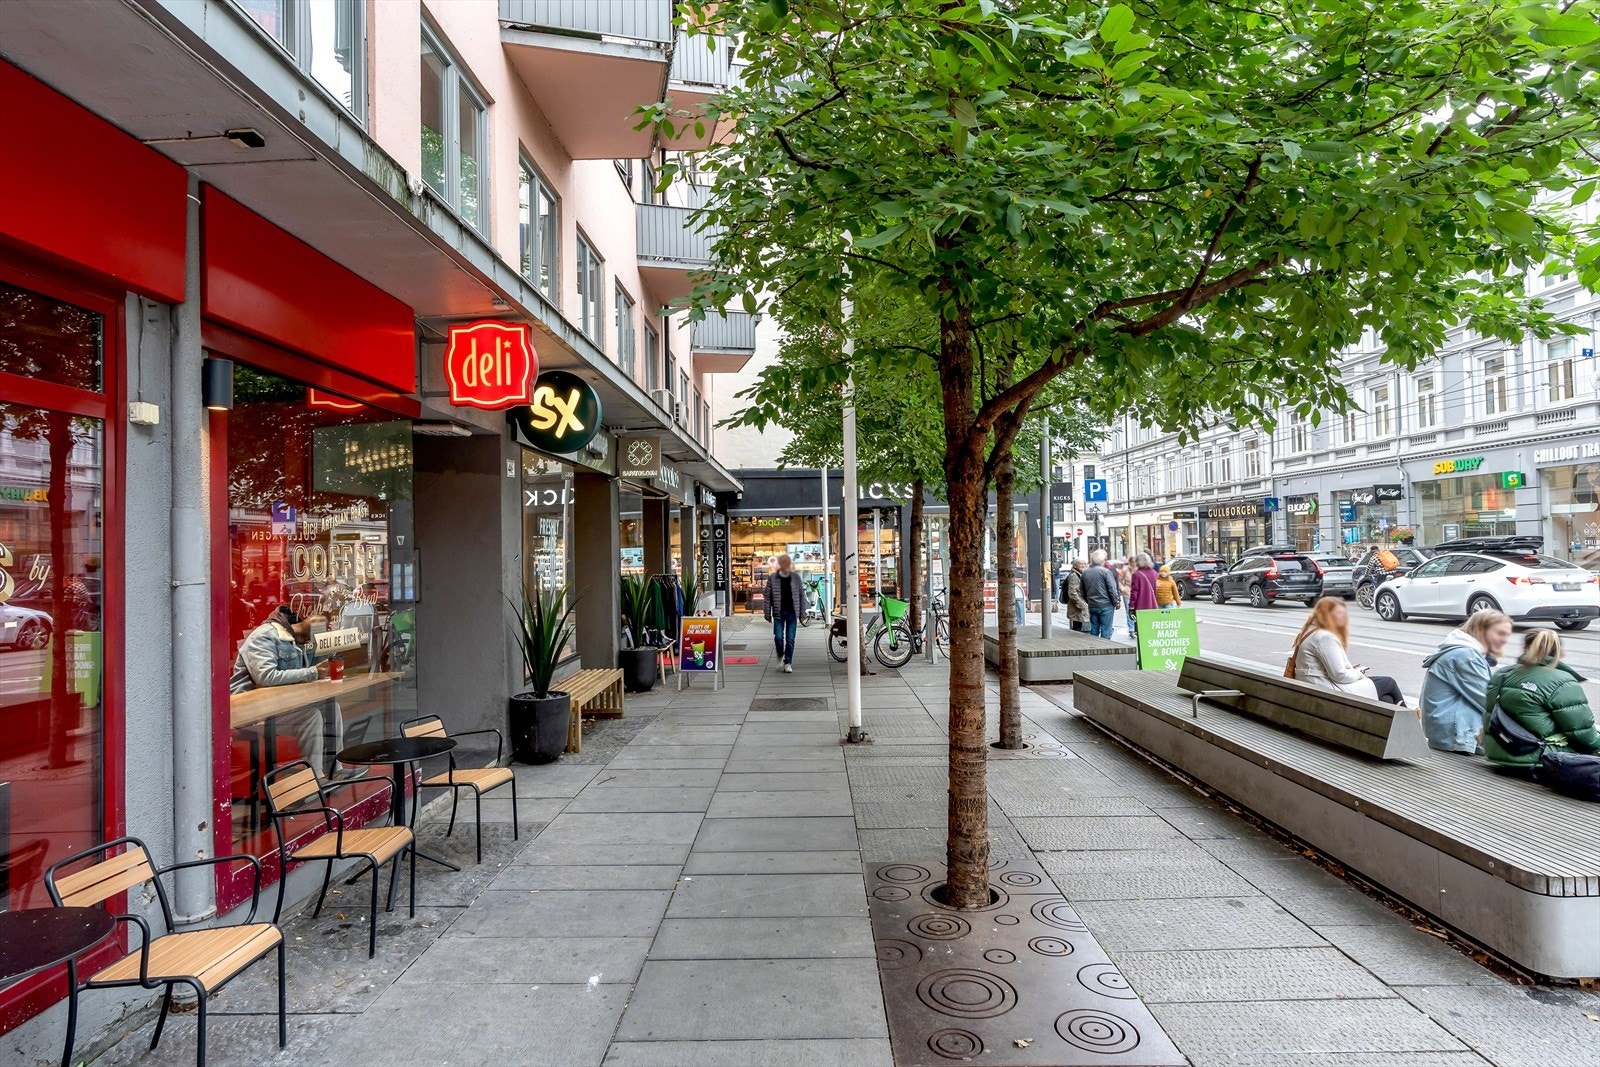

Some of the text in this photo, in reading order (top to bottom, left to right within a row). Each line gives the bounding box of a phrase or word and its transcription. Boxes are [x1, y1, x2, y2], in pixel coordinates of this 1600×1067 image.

[462, 337, 511, 388] deli
[530, 386, 585, 439] SX
[1533, 446, 1580, 463] CHILLOUT
[1433, 456, 1484, 475] SUBWAY
[1089, 482, 1102, 499] P
[1208, 505, 1257, 518] GULLBORGEN
[293, 544, 376, 583] COFFEE
[29, 555, 50, 590] by
[1152, 620, 1183, 630] FRESHLY
[320, 637, 332, 650] DELI
[334, 636, 342, 646] DE
[343, 633, 357, 645] LUCA
[1157, 630, 1179, 638] MADE
[1148, 638, 1190, 648] SMOOTHIES
[1161, 647, 1187, 656] BOWLS
